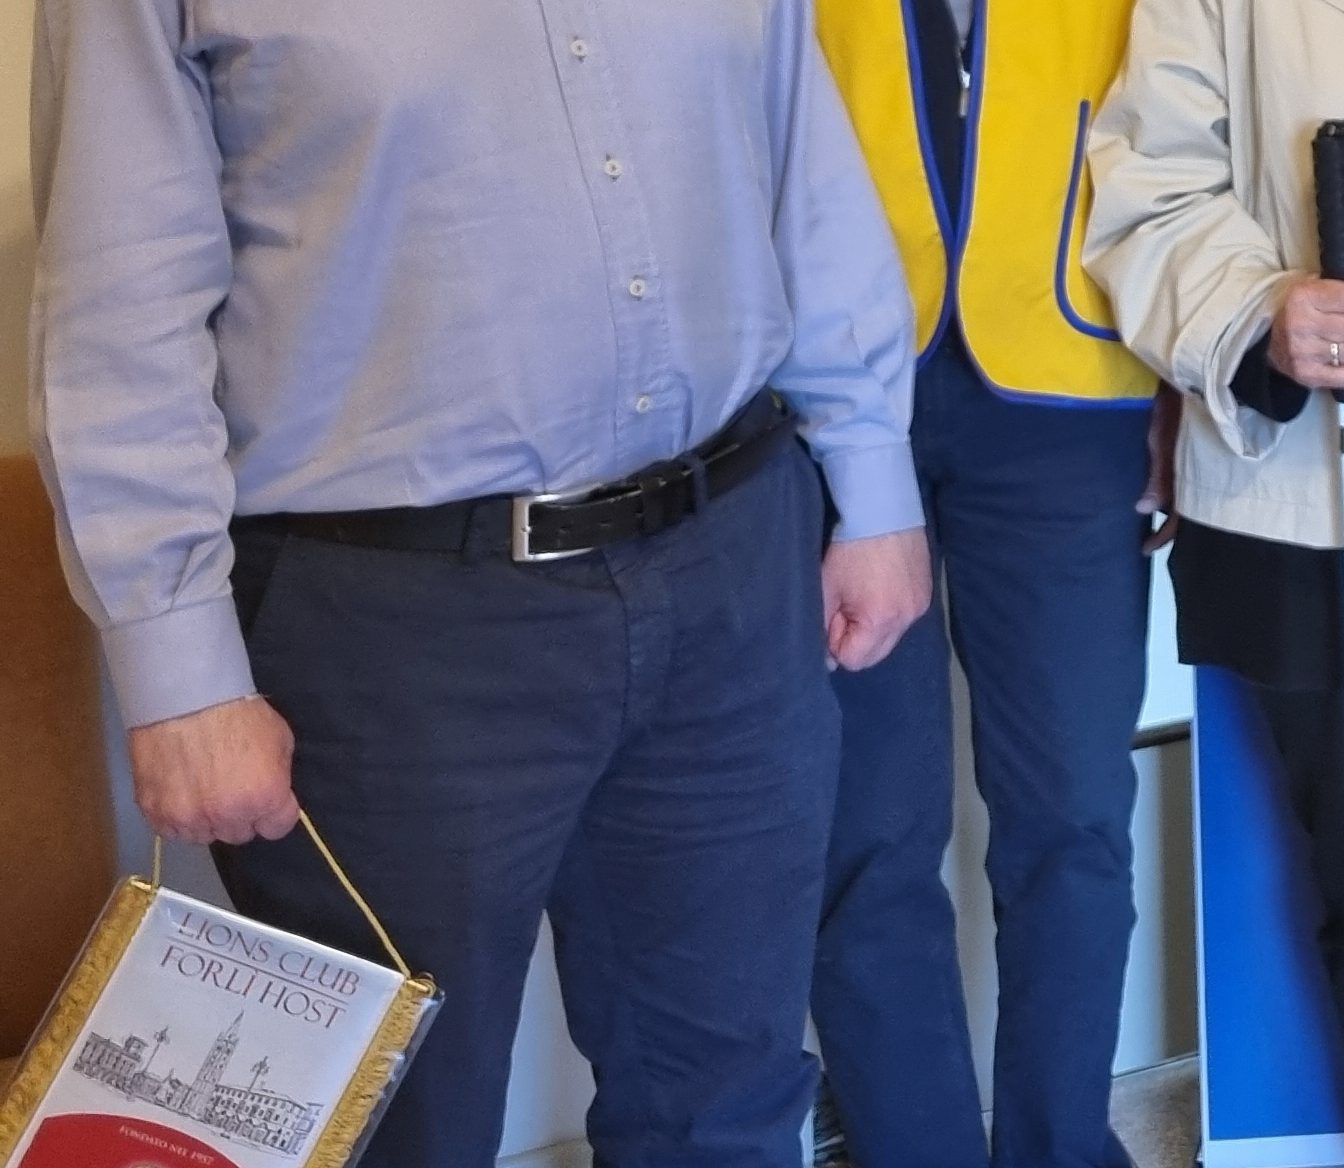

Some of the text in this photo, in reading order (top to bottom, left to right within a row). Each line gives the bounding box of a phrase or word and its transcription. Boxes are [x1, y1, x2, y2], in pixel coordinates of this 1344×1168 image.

[178, 912, 361, 996] LIONS CLUB
[258, 981, 347, 1029] HOST
